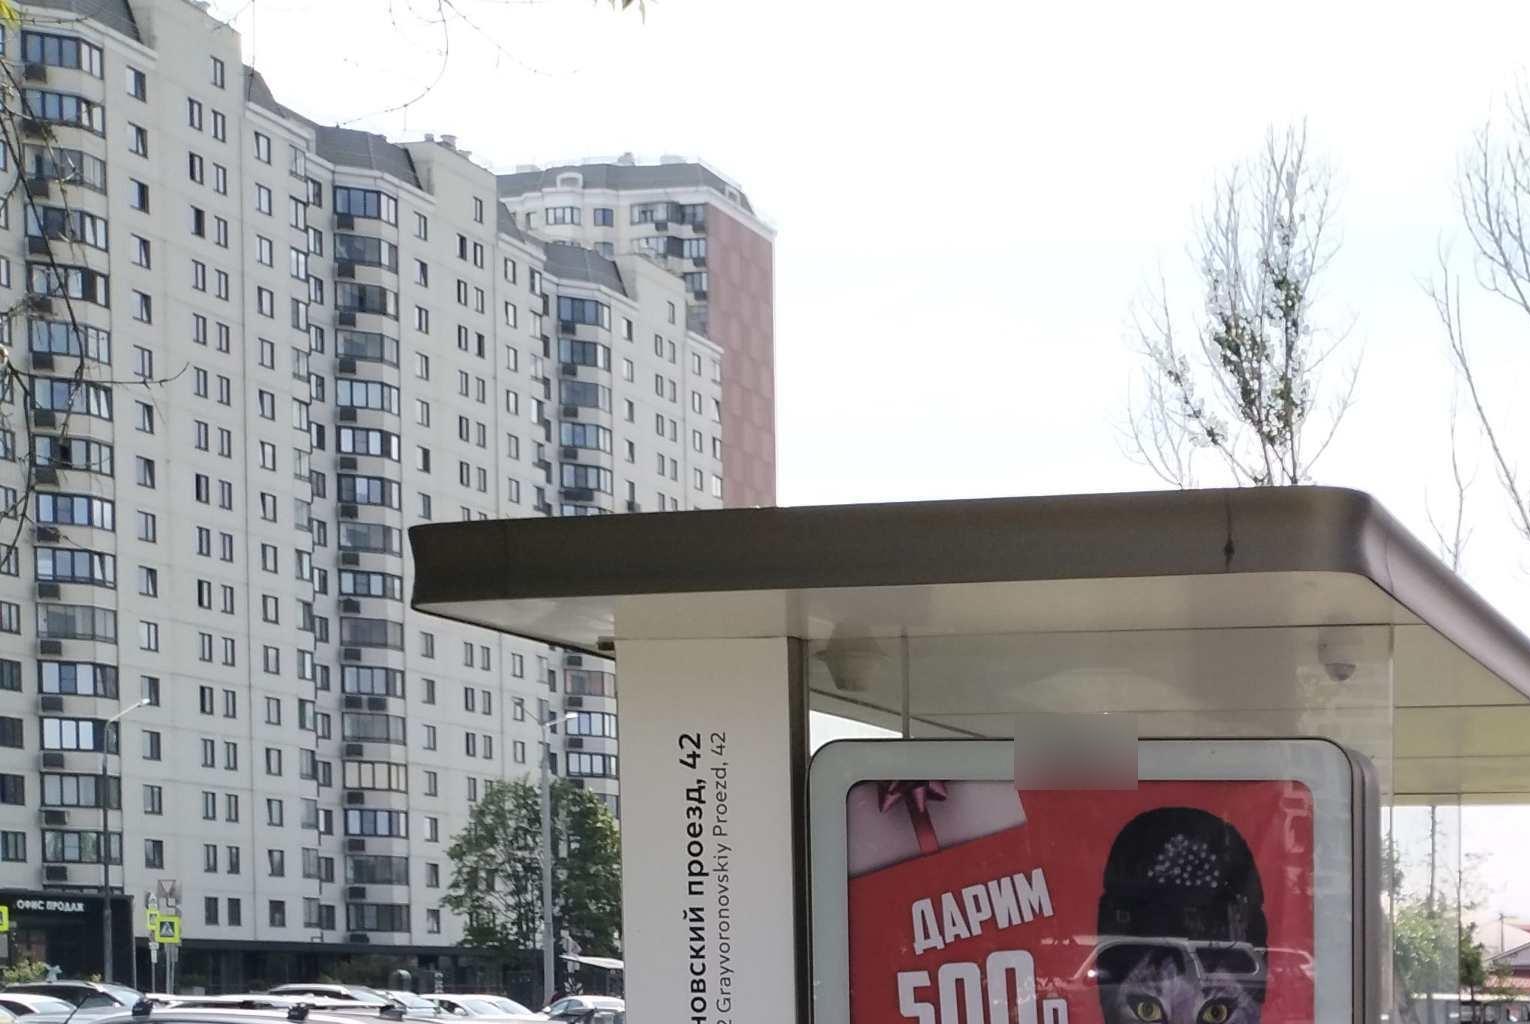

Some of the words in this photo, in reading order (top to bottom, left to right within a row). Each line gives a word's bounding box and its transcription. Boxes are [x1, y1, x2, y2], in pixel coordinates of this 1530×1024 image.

[679, 732, 702, 770] 42
[711, 732, 726, 756] 42
[711, 762, 729, 836] Proezd,
[685, 778, 709, 896] проезд,
[16, 899, 45, 911] ОФИС
[46, 901, 84, 912] ПРОДАЖ
[713, 842, 734, 1013] Grayvoronovskiy
[912, 867, 1054, 956] ДАРИМ
